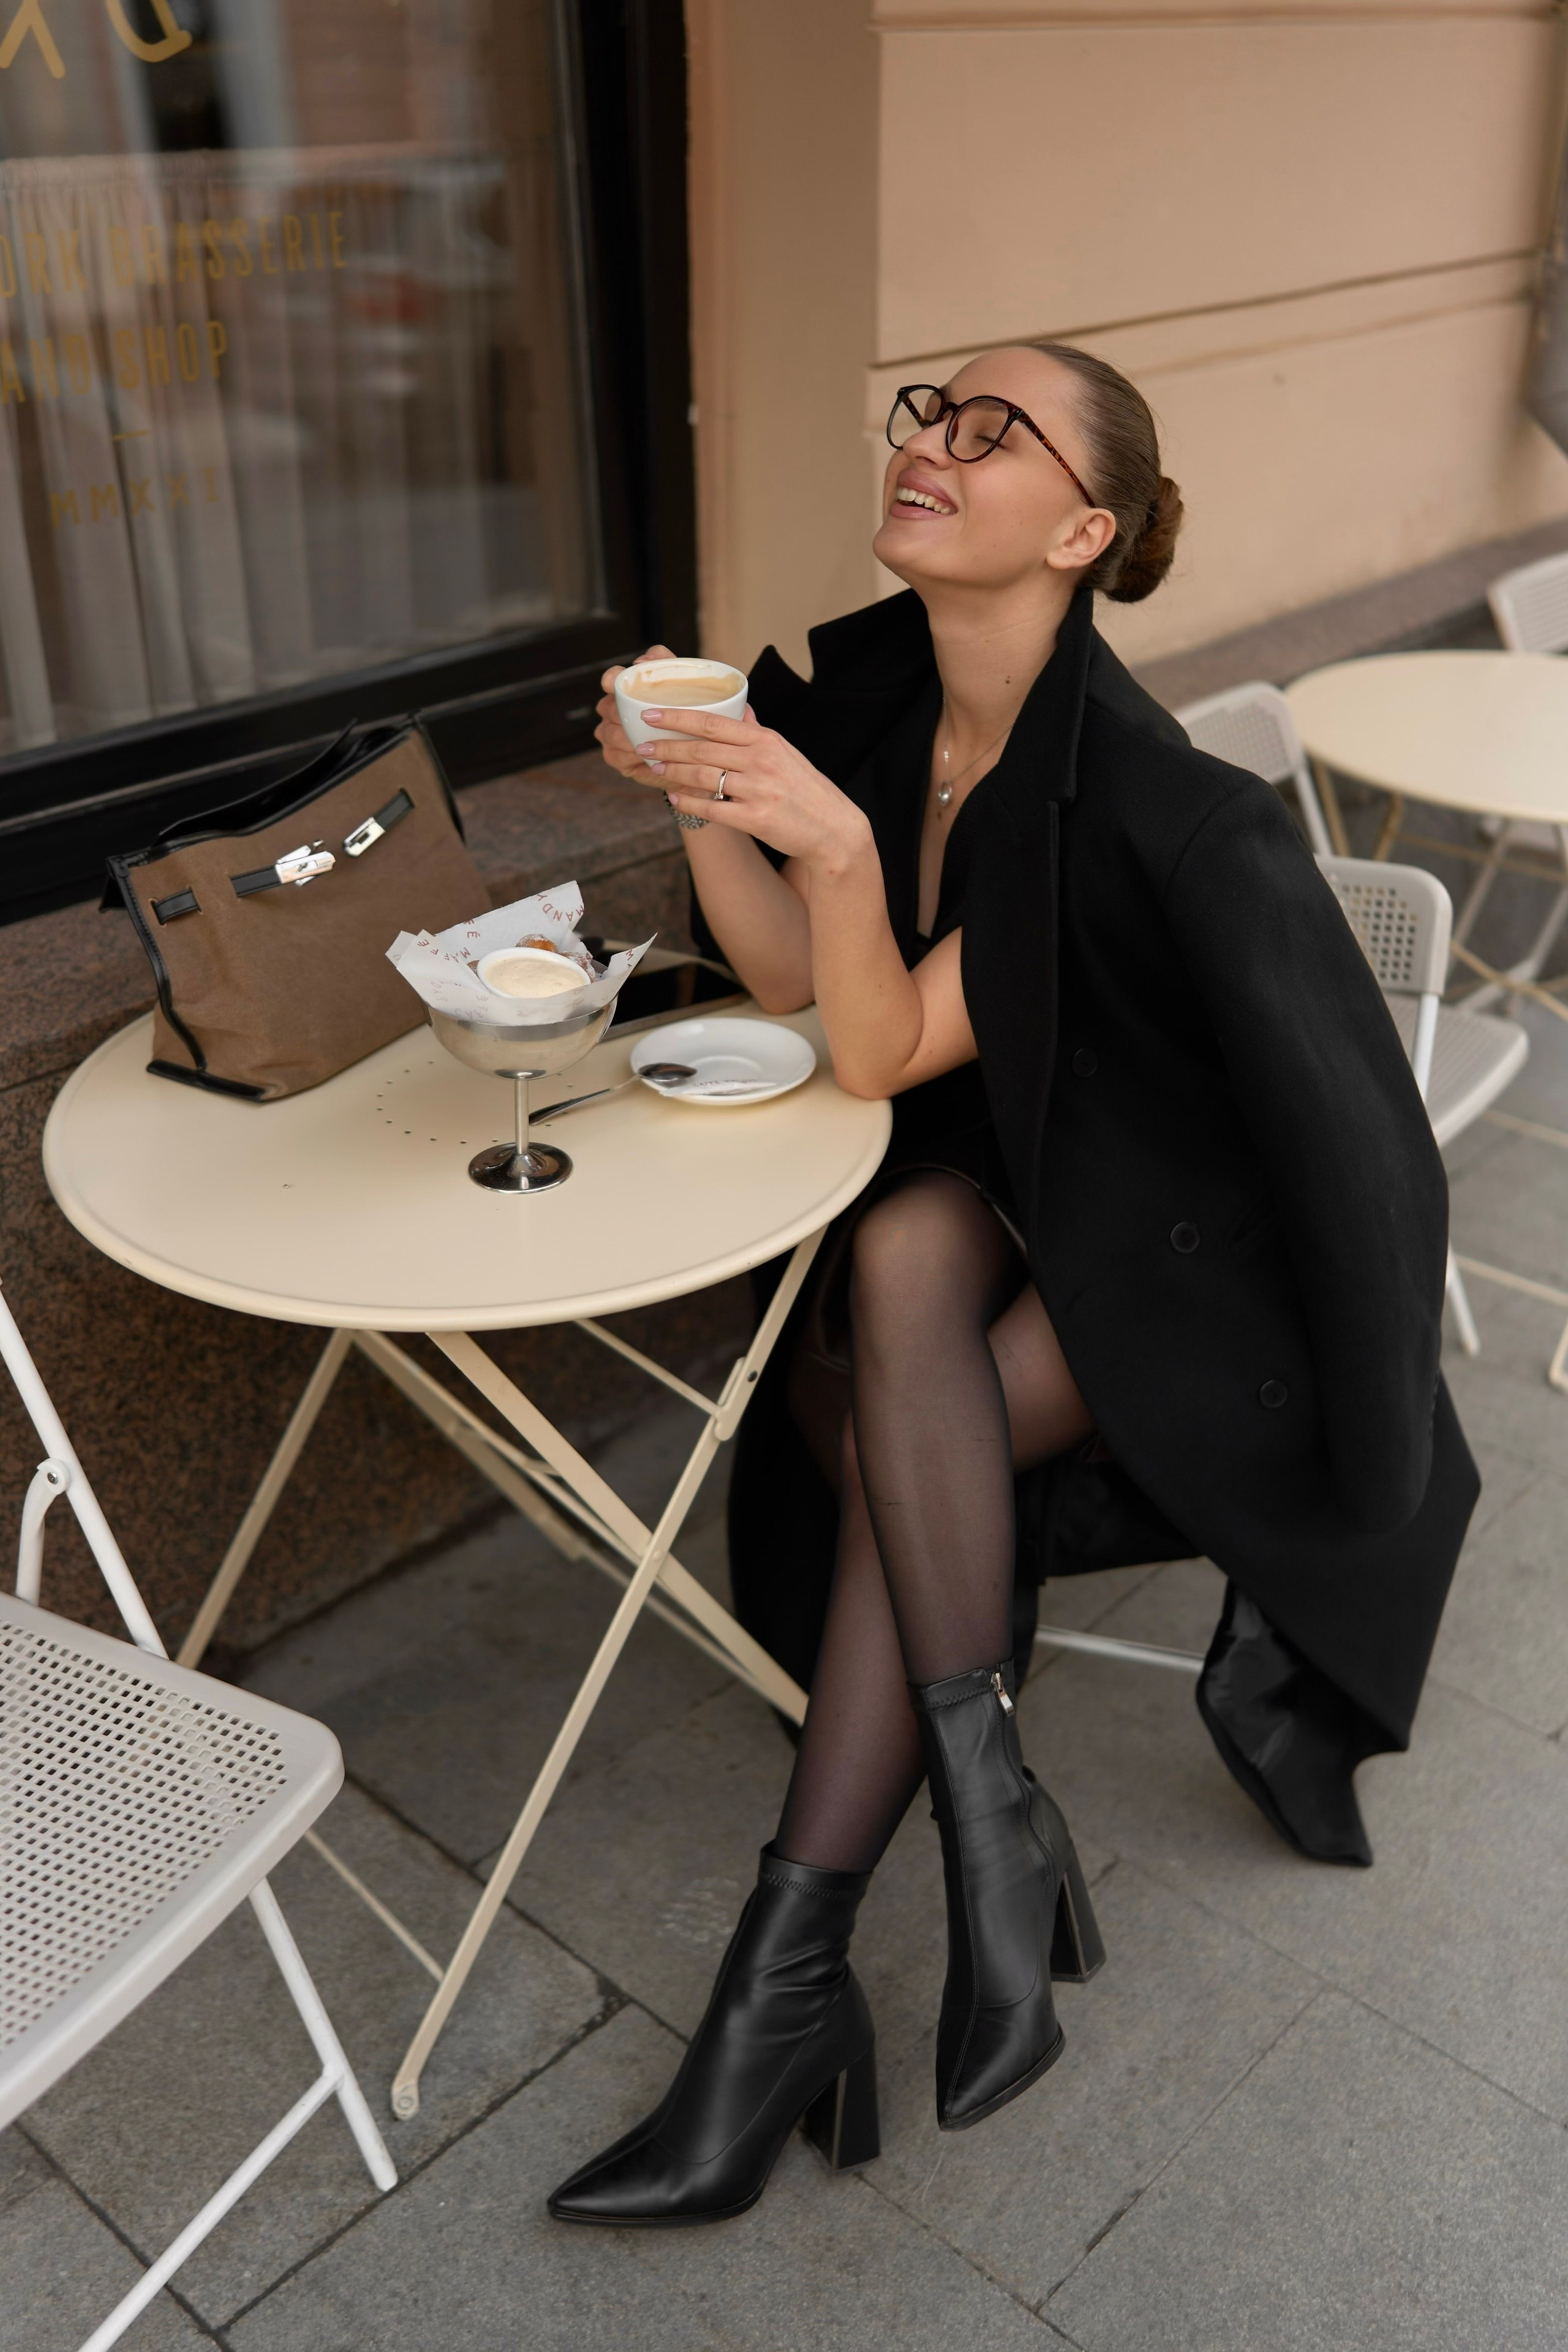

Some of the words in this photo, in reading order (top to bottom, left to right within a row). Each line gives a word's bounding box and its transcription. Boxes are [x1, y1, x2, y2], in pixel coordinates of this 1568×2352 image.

[110, 211, 348, 287] BRASSERIE
[0, 334, 91, 404] AND
[115, 321, 227, 390] SHOP
[50, 467, 221, 529] MMXXI
